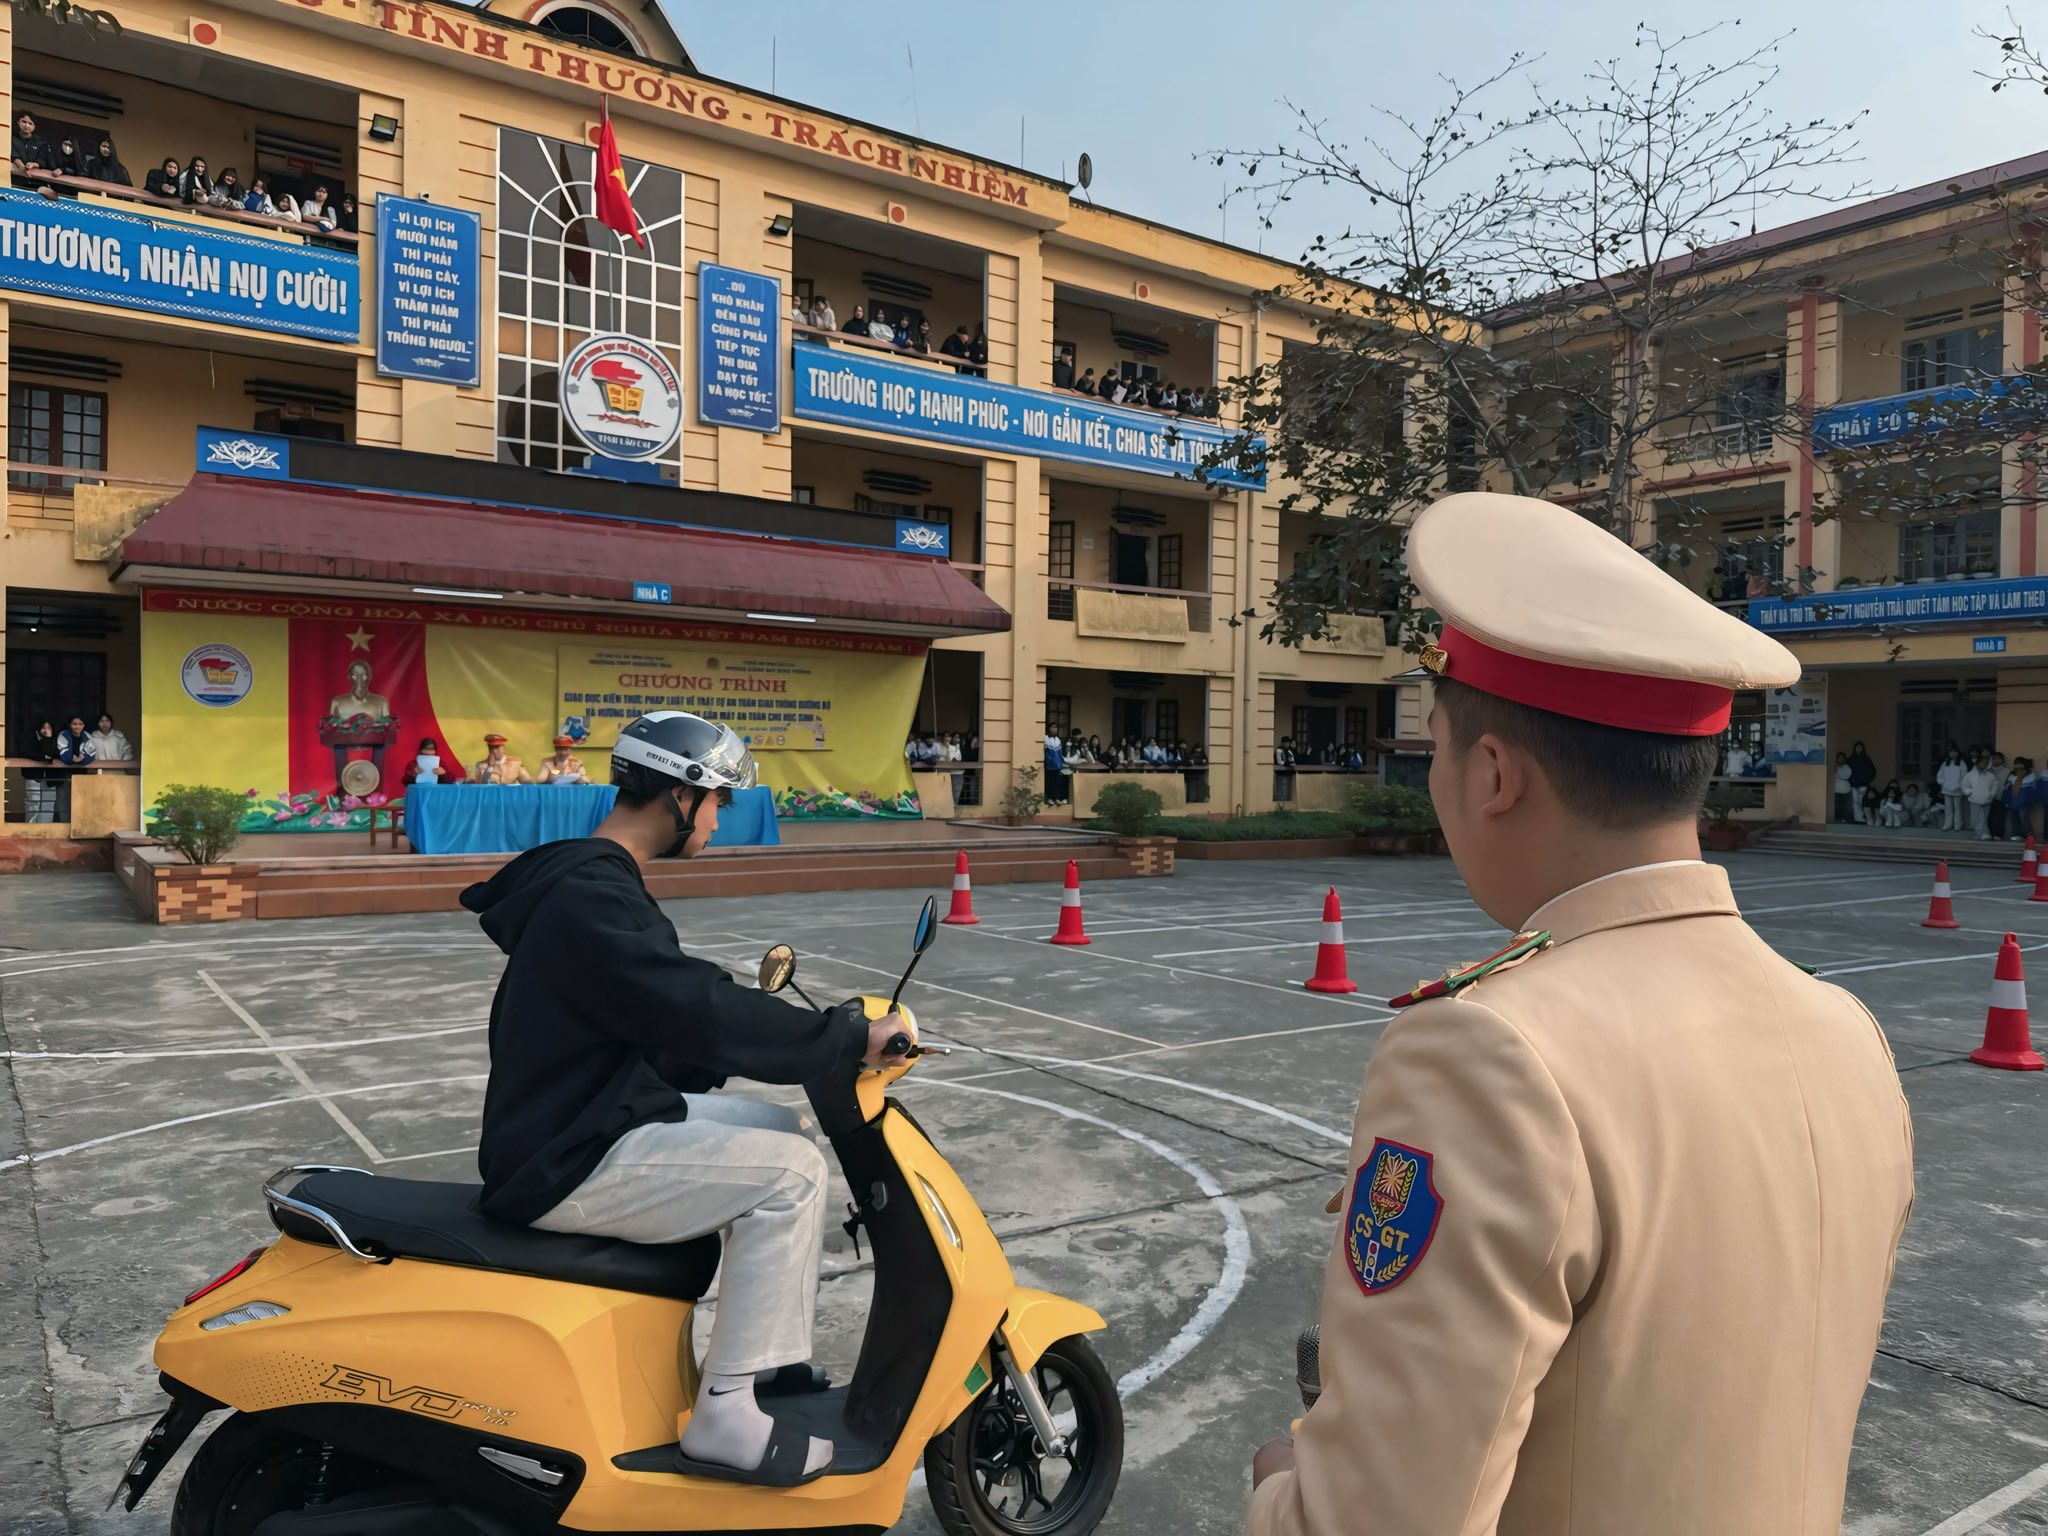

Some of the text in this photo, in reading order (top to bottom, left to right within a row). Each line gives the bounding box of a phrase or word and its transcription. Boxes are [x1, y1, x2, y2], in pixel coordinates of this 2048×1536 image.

[372, 0, 508, 60] TÌNH
[523, 42, 729, 120] THƯƠNG
[765, 112, 903, 172] TRÁCH
[912, 156, 1029, 206] NHIỆM
[0, 219, 347, 315] THƯƠNG, NHẬN NỤ CƯỜI!
[424, 251, 451, 266] PHẢI
[423, 319, 451, 334] PHẢI
[708, 384, 723, 396] VÀ
[808, 367, 877, 409] TRƯỜNG
[882, 382, 915, 419] HỌC
[920, 389, 964, 426] HẠNH
[968, 397, 1009, 432] PHÚC
[1023, 408, 1048, 439] NƠI
[1052, 407, 1081, 445] GẮN
[1085, 415, 1112, 453] KẾT,
[1115, 427, 1147, 457] CHIA
[637, 586, 668, 602] NHÀ C
[1905, 593, 1930, 617] QUYẾT
[1932, 593, 1949, 613] TÂM
[1952, 594, 1969, 615] HỌC
[1970, 591, 1986, 615] TẬP
[1989, 589, 2000, 610] VÀ
[2002, 589, 2021, 609] LÀM
[2023, 590, 2045, 608] THEO
[177, 597, 262, 612] NƯỚC
[271, 602, 353, 617] CỘNG
[363, 606, 424, 620] HÒA
[433, 611, 472, 624] XÃ
[536, 616, 586, 631] CHỦ
[596, 622, 673, 637] NGHĨA
[681, 628, 736, 642] VIỆT
[740, 631, 787, 645] NAM
[618, 673, 787, 693] CHƯƠNG TRÌNH
[320, 1364, 465, 1419] EVO
